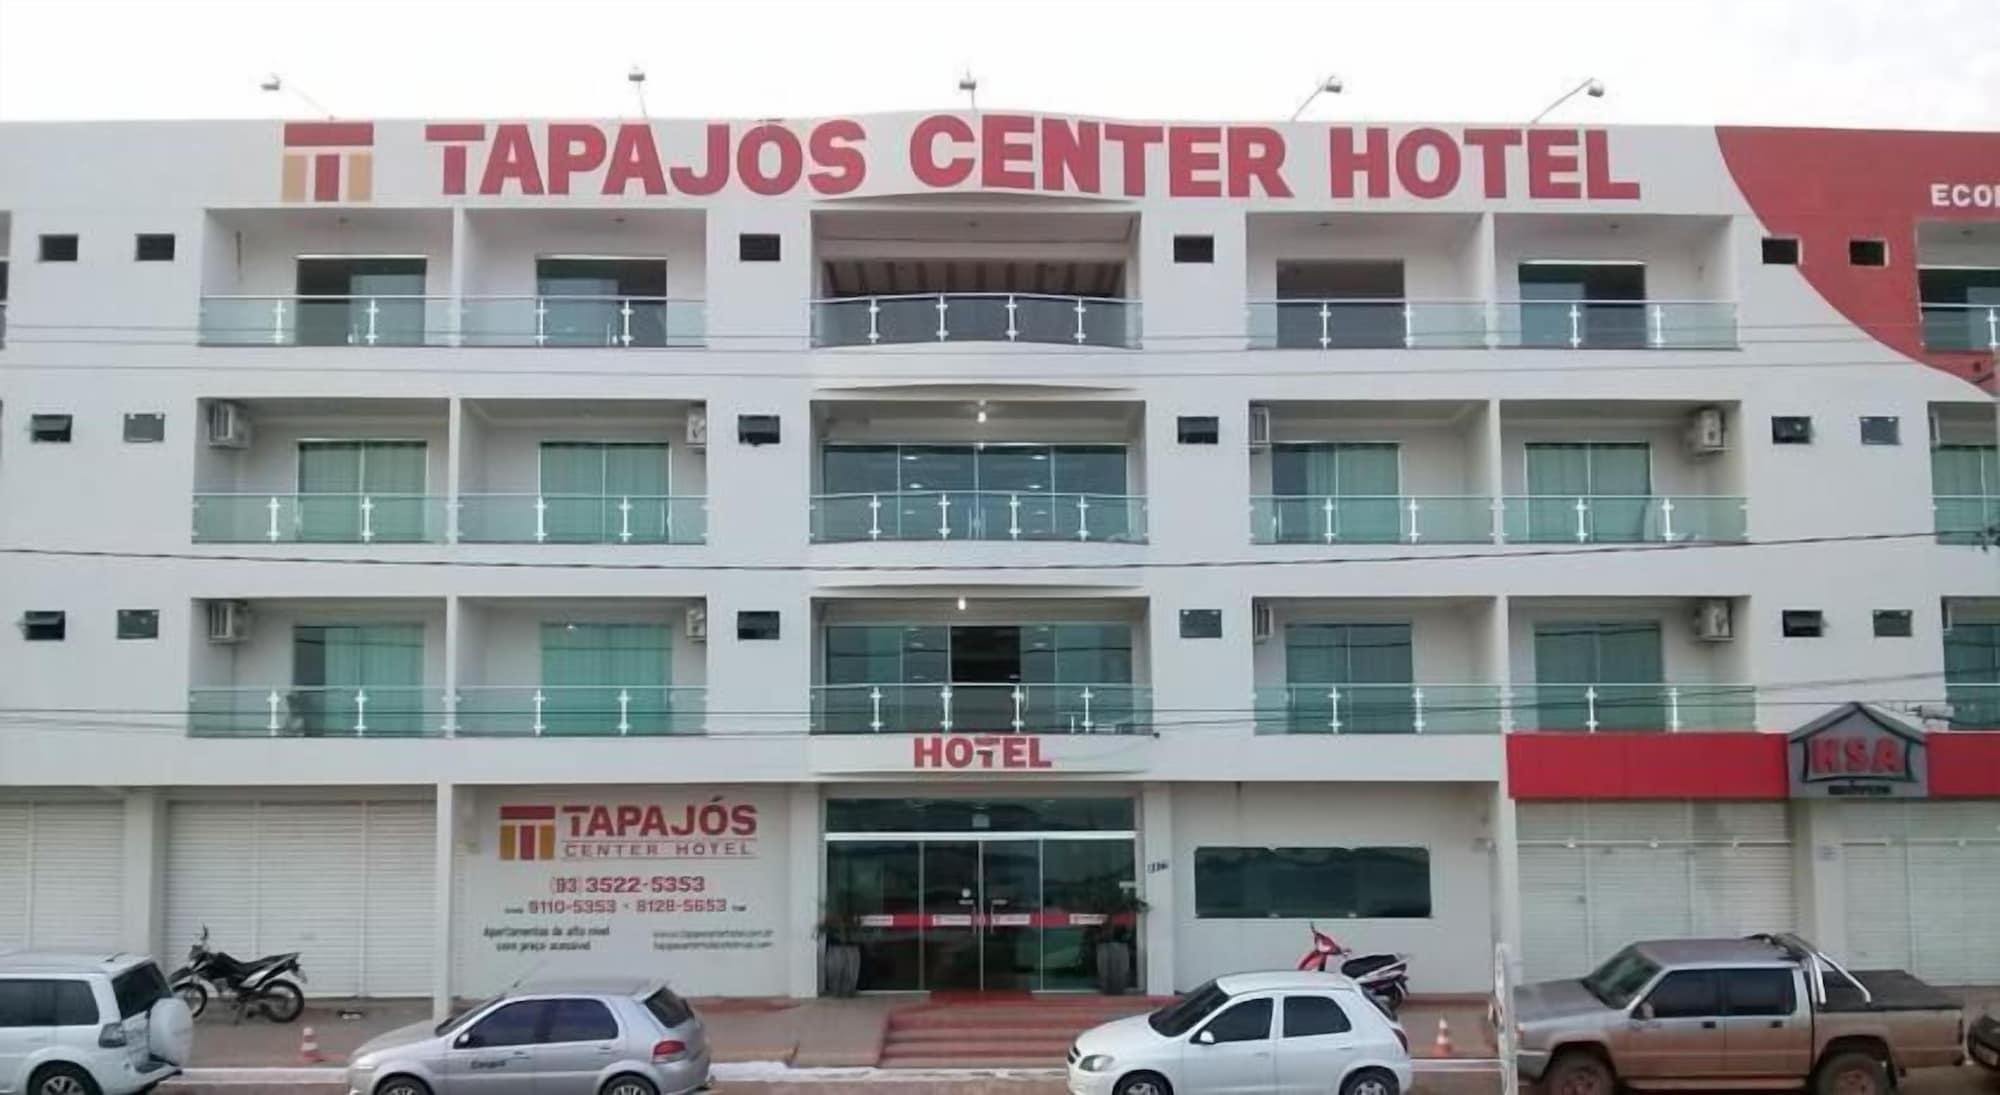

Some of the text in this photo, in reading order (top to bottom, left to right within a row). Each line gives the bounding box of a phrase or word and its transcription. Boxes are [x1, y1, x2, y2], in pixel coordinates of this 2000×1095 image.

[909, 114, 1294, 198] CENTER
[1330, 127, 1641, 199] HOTEL
[914, 736, 1052, 768] HOTEL
[562, 796, 757, 837] TAPAJÓS
[565, 841, 754, 858] CENTER HOTEL
[585, 874, 706, 893] 3522-5353
[527, 898, 617, 914] 9110-5353
